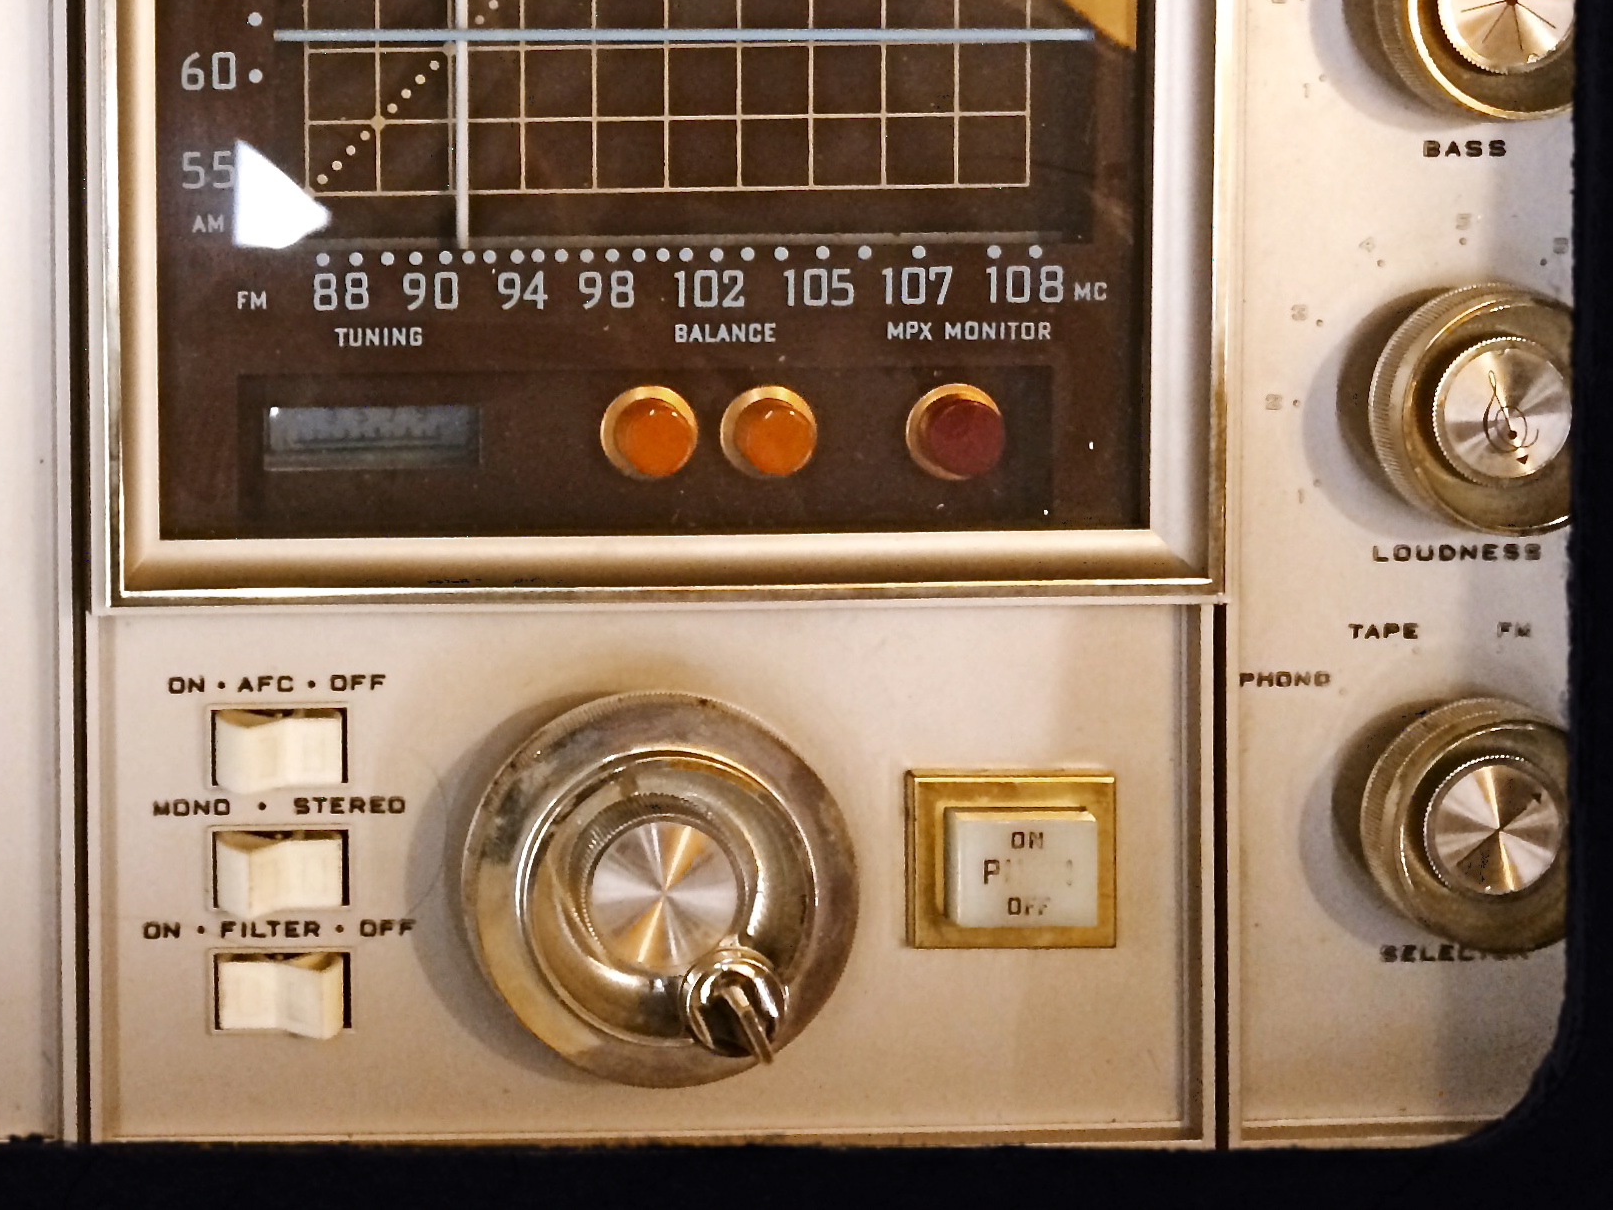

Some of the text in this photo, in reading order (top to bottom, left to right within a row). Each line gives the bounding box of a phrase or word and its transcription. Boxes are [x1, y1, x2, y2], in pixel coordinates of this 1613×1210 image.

[181, 51, 237, 91] 60
[1422, 140, 1507, 158] BASS
[182, 151, 236, 189] 55
[192, 215, 224, 233] AM
[237, 265, 1107, 311] FM 88 90 94 98 102 105 107 108 MC
[335, 327, 423, 347] TUNING
[674, 323, 776, 343] BALANCE
[887, 321, 1051, 340] MPX MONITOR
[1372, 544, 1542, 562] LOUDNESS
[1348, 623, 1419, 640] TAPE
[168, 674, 386, 694] ON AFC OFF
[1239, 672, 1331, 687] PHONO
[153, 796, 406, 816] MONO STEREO
[1011, 832, 1044, 849] ON
[143, 919, 416, 939] ON FILTER OFF
